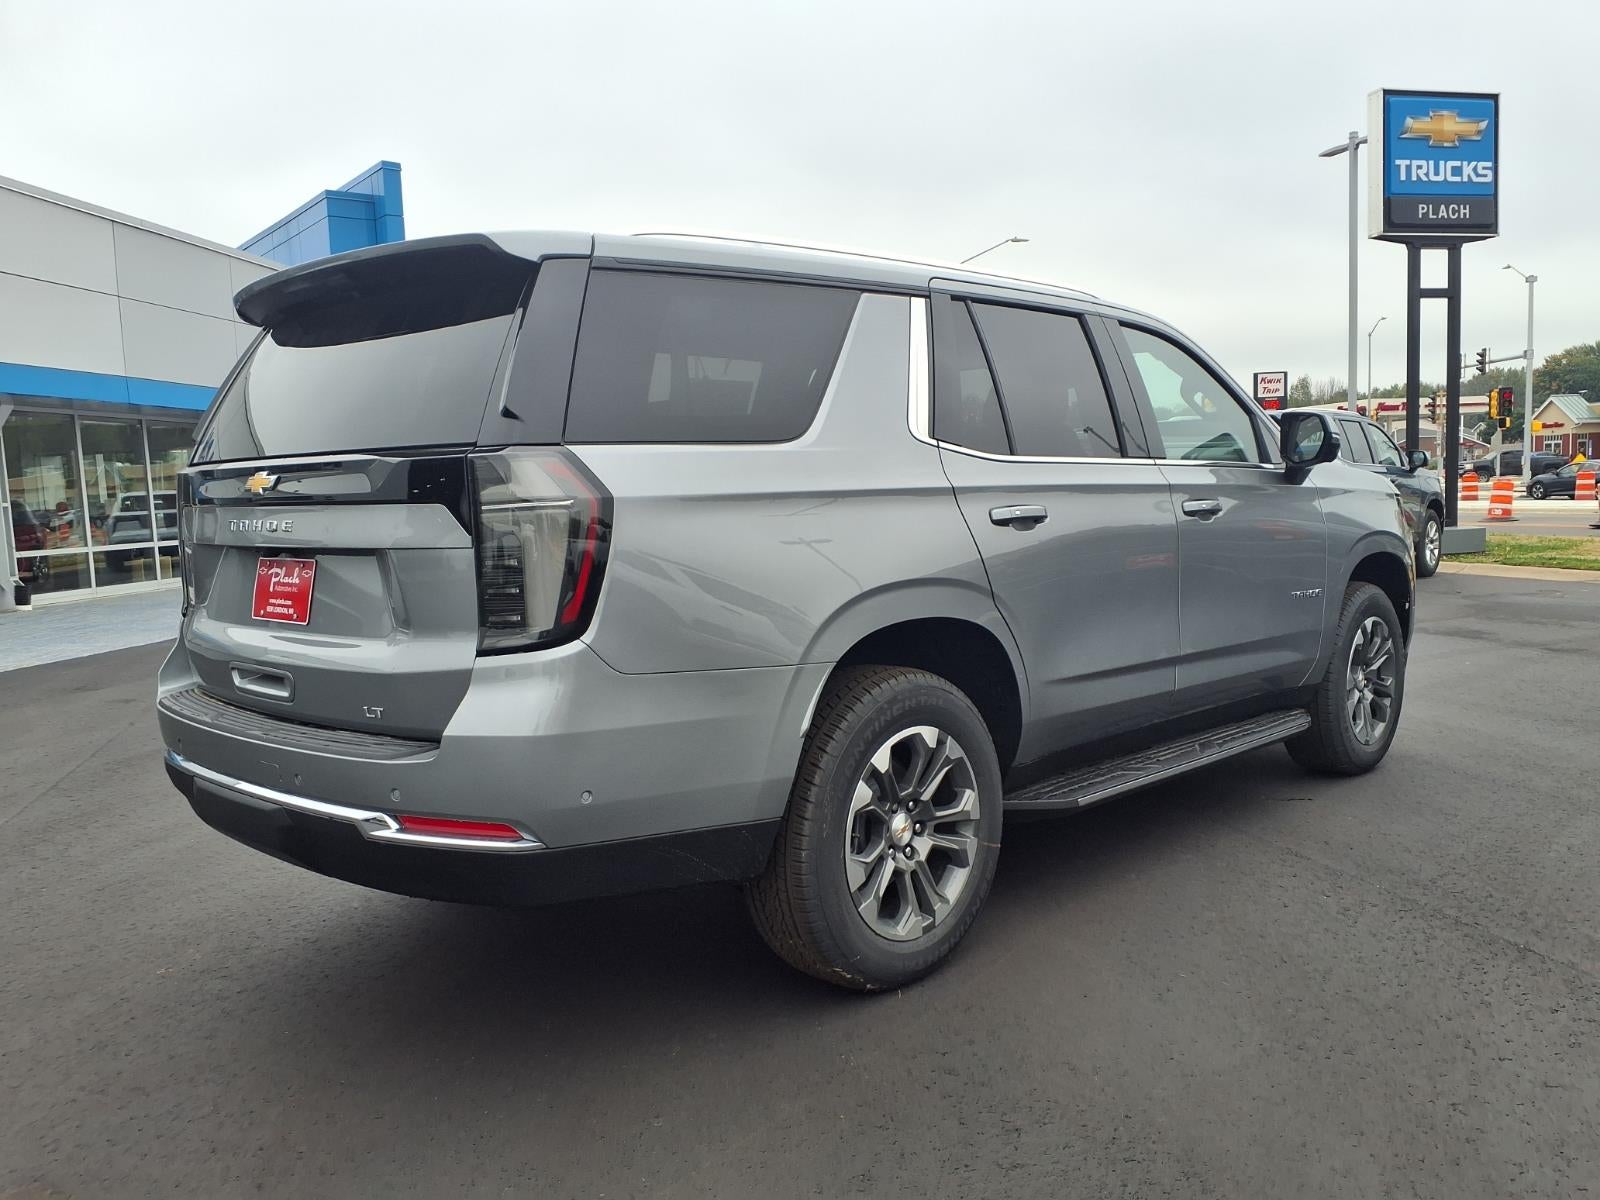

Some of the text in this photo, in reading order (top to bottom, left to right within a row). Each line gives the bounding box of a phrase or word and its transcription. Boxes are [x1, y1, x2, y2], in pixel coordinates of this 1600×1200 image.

[1395, 159, 1493, 183] TRUCKS
[1418, 203, 1470, 219] PLACH
[228, 519, 294, 533] TAHOE
[268, 563, 300, 592] Plach
[362, 706, 384, 719] LT
